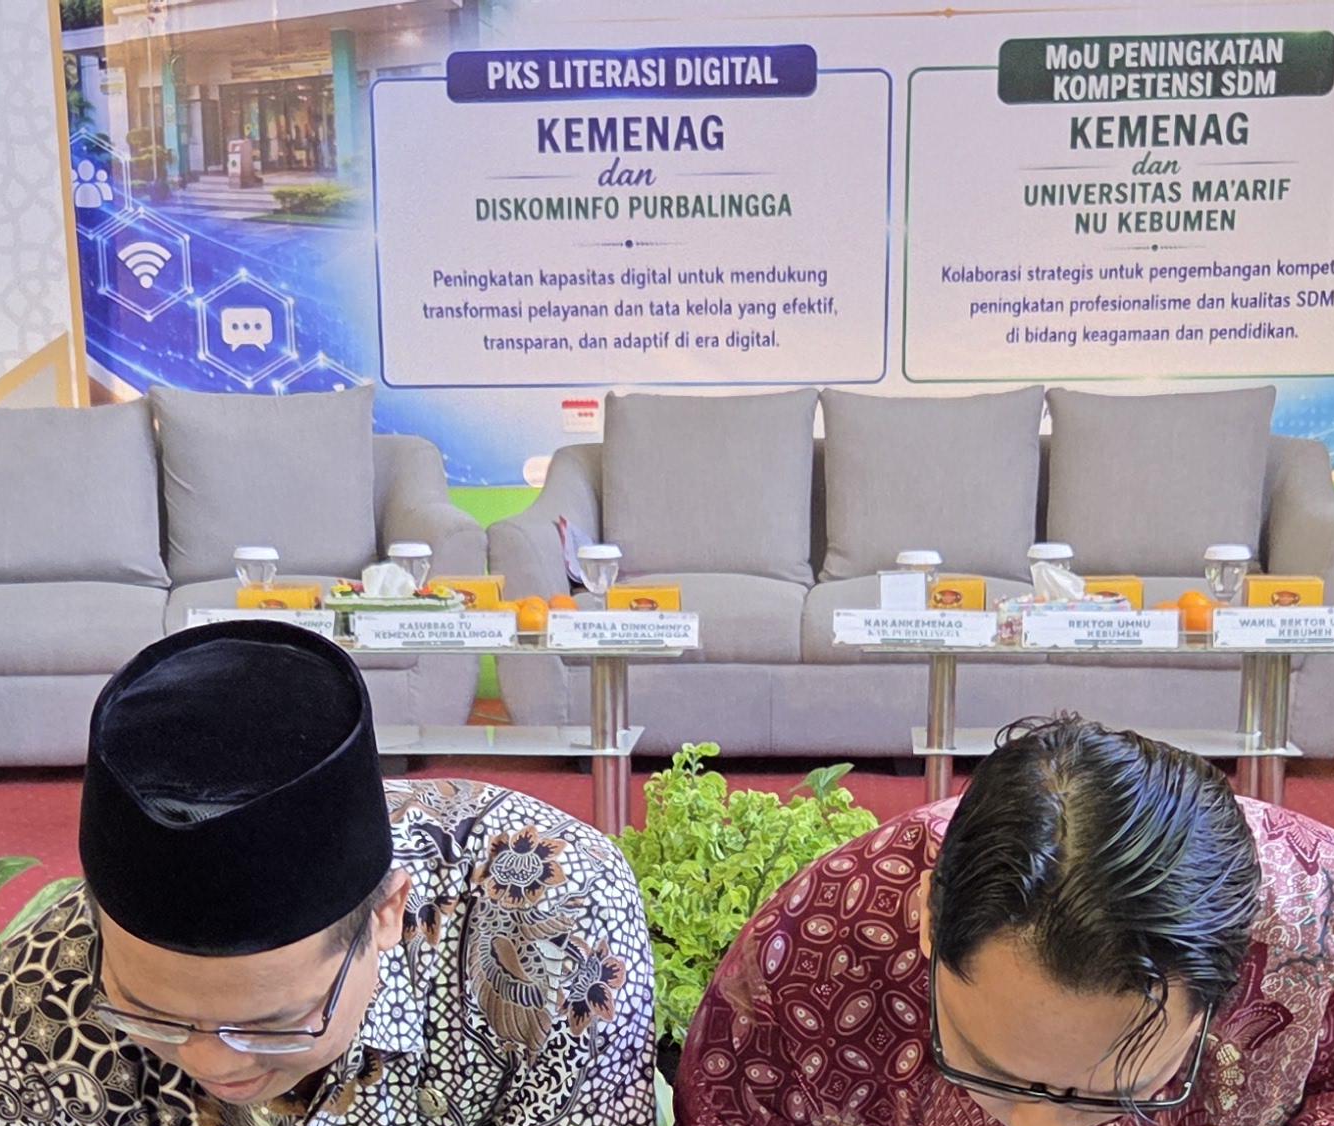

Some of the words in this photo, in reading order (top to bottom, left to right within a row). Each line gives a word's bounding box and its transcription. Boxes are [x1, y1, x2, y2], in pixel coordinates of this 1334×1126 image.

[1046, 42, 1100, 70] MoU
[1109, 38, 1283, 68] PENINGKATAN
[487, 61, 539, 90] PKS
[549, 59, 666, 89] LITERASI
[676, 56, 778, 87] DIGITAL
[1054, 72, 1212, 101] KOMPETENSI
[1221, 70, 1276, 96] SDM
[537, 115, 725, 153] KEMENAG
[1070, 112, 1249, 150] KEMENAG
[598, 157, 657, 187] dan
[1132, 151, 1181, 176] dan
[1024, 182, 1182, 206] UNIVERSITAS
[1192, 178, 1291, 203] MA'ARIF
[476, 195, 619, 222] DISKOMINFO
[629, 193, 792, 220] PURBALINGGA
[1075, 211, 1107, 234] NU
[1117, 209, 1236, 233] KEBUMEN
[433, 269, 534, 291] Peningkatan
[540, 268, 615, 289] kapasitas
[621, 267, 672, 287] digital
[678, 267, 725, 285] untuk
[731, 267, 828, 287] mendukung
[942, 265, 1022, 283] Kolaborasi
[1027, 263, 1093, 285] strategis
[1100, 263, 1144, 280] untuk
[1149, 260, 1271, 284] pengembangan
[423, 301, 522, 320] transformasi
[528, 301, 608, 322] pelayanan
[615, 300, 644, 317] dan
[650, 301, 680, 317] tata
[687, 299, 732, 316] kelola
[738, 302, 777, 320] yang
[783, 298, 838, 317] efektif,
[970, 295, 1064, 316] peningkatan
[1070, 292, 1190, 314] profesionalisme
[1197, 292, 1225, 309] dan
[1231, 291, 1290, 308] kualitas
[1297, 290, 1334, 308] SDM
[483, 334, 573, 353] transparan,
[579, 332, 608, 349] dan
[614, 331, 668, 353] adaptif
[675, 331, 690, 348] di
[696, 334, 720, 348] era
[726, 330, 780, 350] digital.
[1006, 326, 1020, 343] di
[1025, 325, 1077, 347] bidang
[1083, 324, 1169, 345] keagamaan
[1175, 323, 1204, 340] dan
[1209, 321, 1298, 343] pendidikan.
[458, 622, 471, 630] TU
[574, 622, 617, 630] KEPALA
[864, 619, 963, 629] KAKANKEMENAG
[1069, 620, 1113, 628] REKTOR
[1087, 630, 1140, 638] KEBUMEN
[1239, 618, 1276, 628] WAKIL
[1280, 618, 1326, 628] REKTOR
[1279, 628, 1332, 637] KEBUMEN
